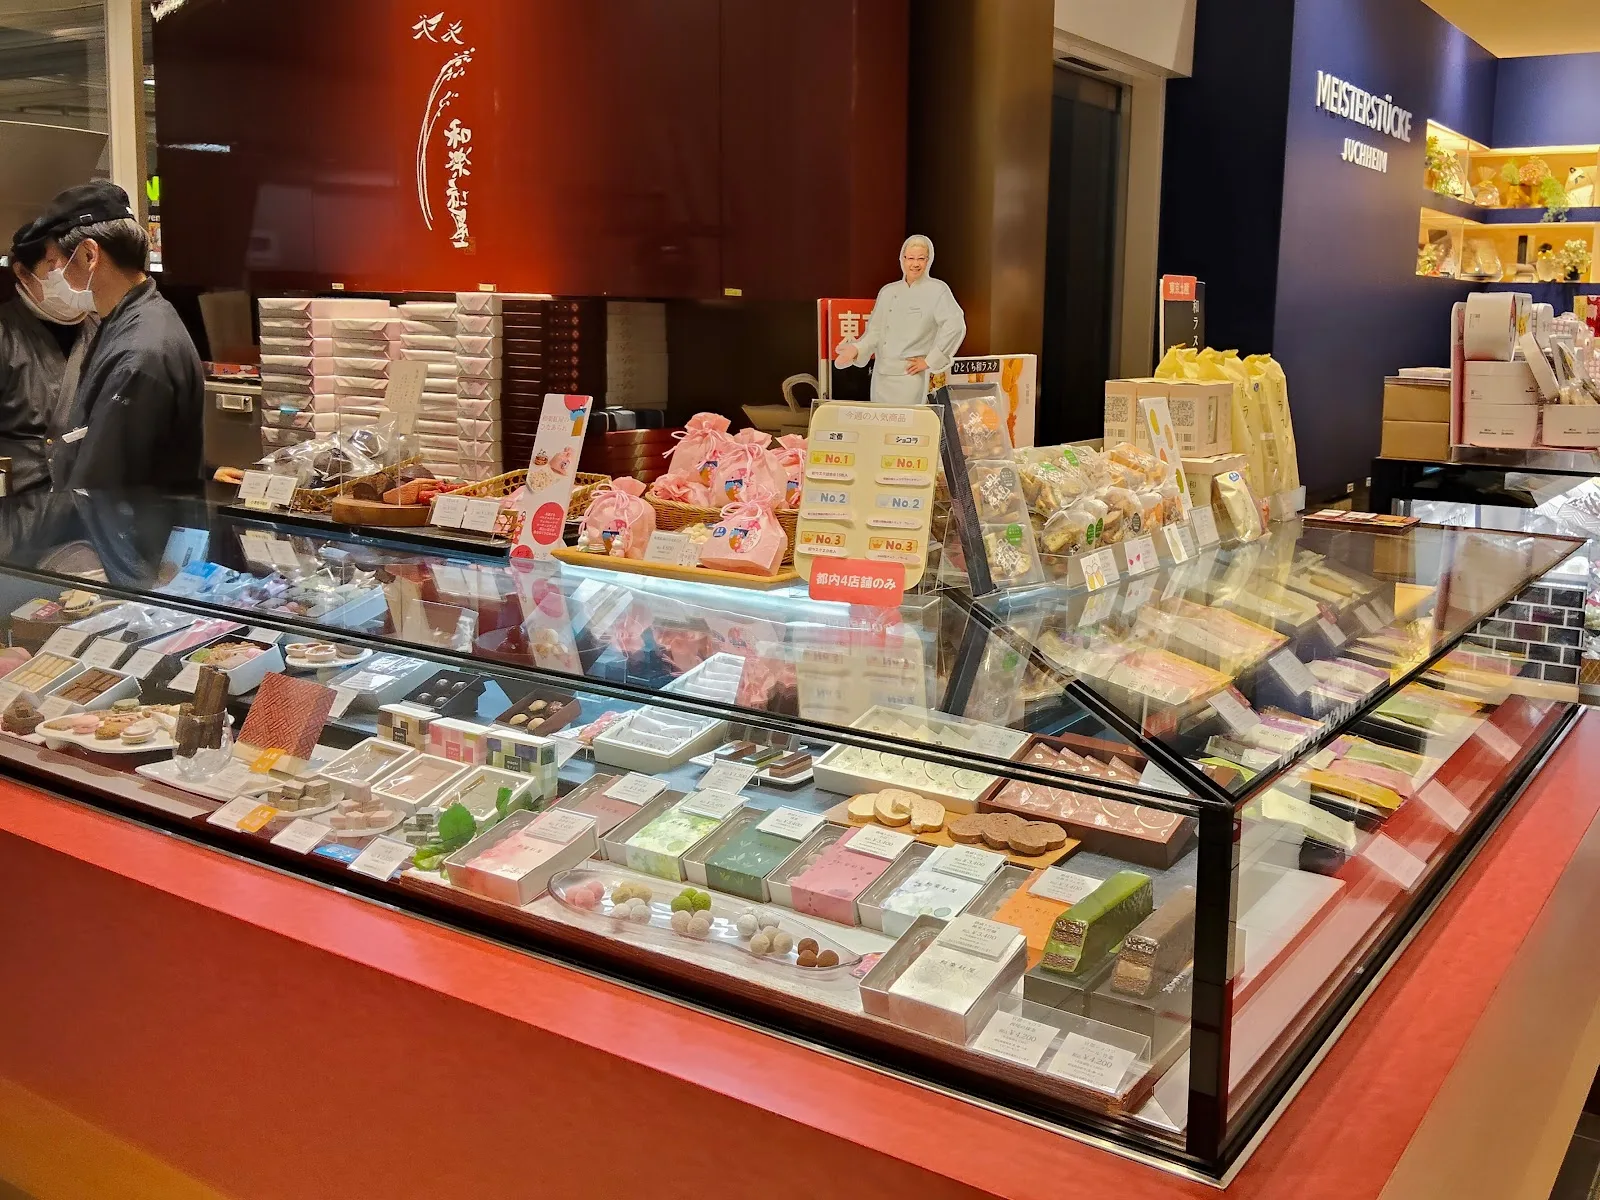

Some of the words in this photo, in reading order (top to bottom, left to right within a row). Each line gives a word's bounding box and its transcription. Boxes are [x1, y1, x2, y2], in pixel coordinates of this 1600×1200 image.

[1316, 70, 1413, 143] MEISTERSTÜCKE
[954, 361, 997, 373] ひとくち和ラスク
[845, 411, 906, 423] 今週の人気商品
[829, 432, 843, 441] 定番
[895, 436, 918, 445] ショコラ
[825, 453, 848, 464] No.1
[896, 458, 921, 469] No.1
[820, 492, 846, 504] No.2
[892, 497, 920, 509] No.2
[815, 534, 841, 545] No.3
[885, 540, 913, 551] No.3
[816, 572, 896, 590] 都内4店舗のみ
